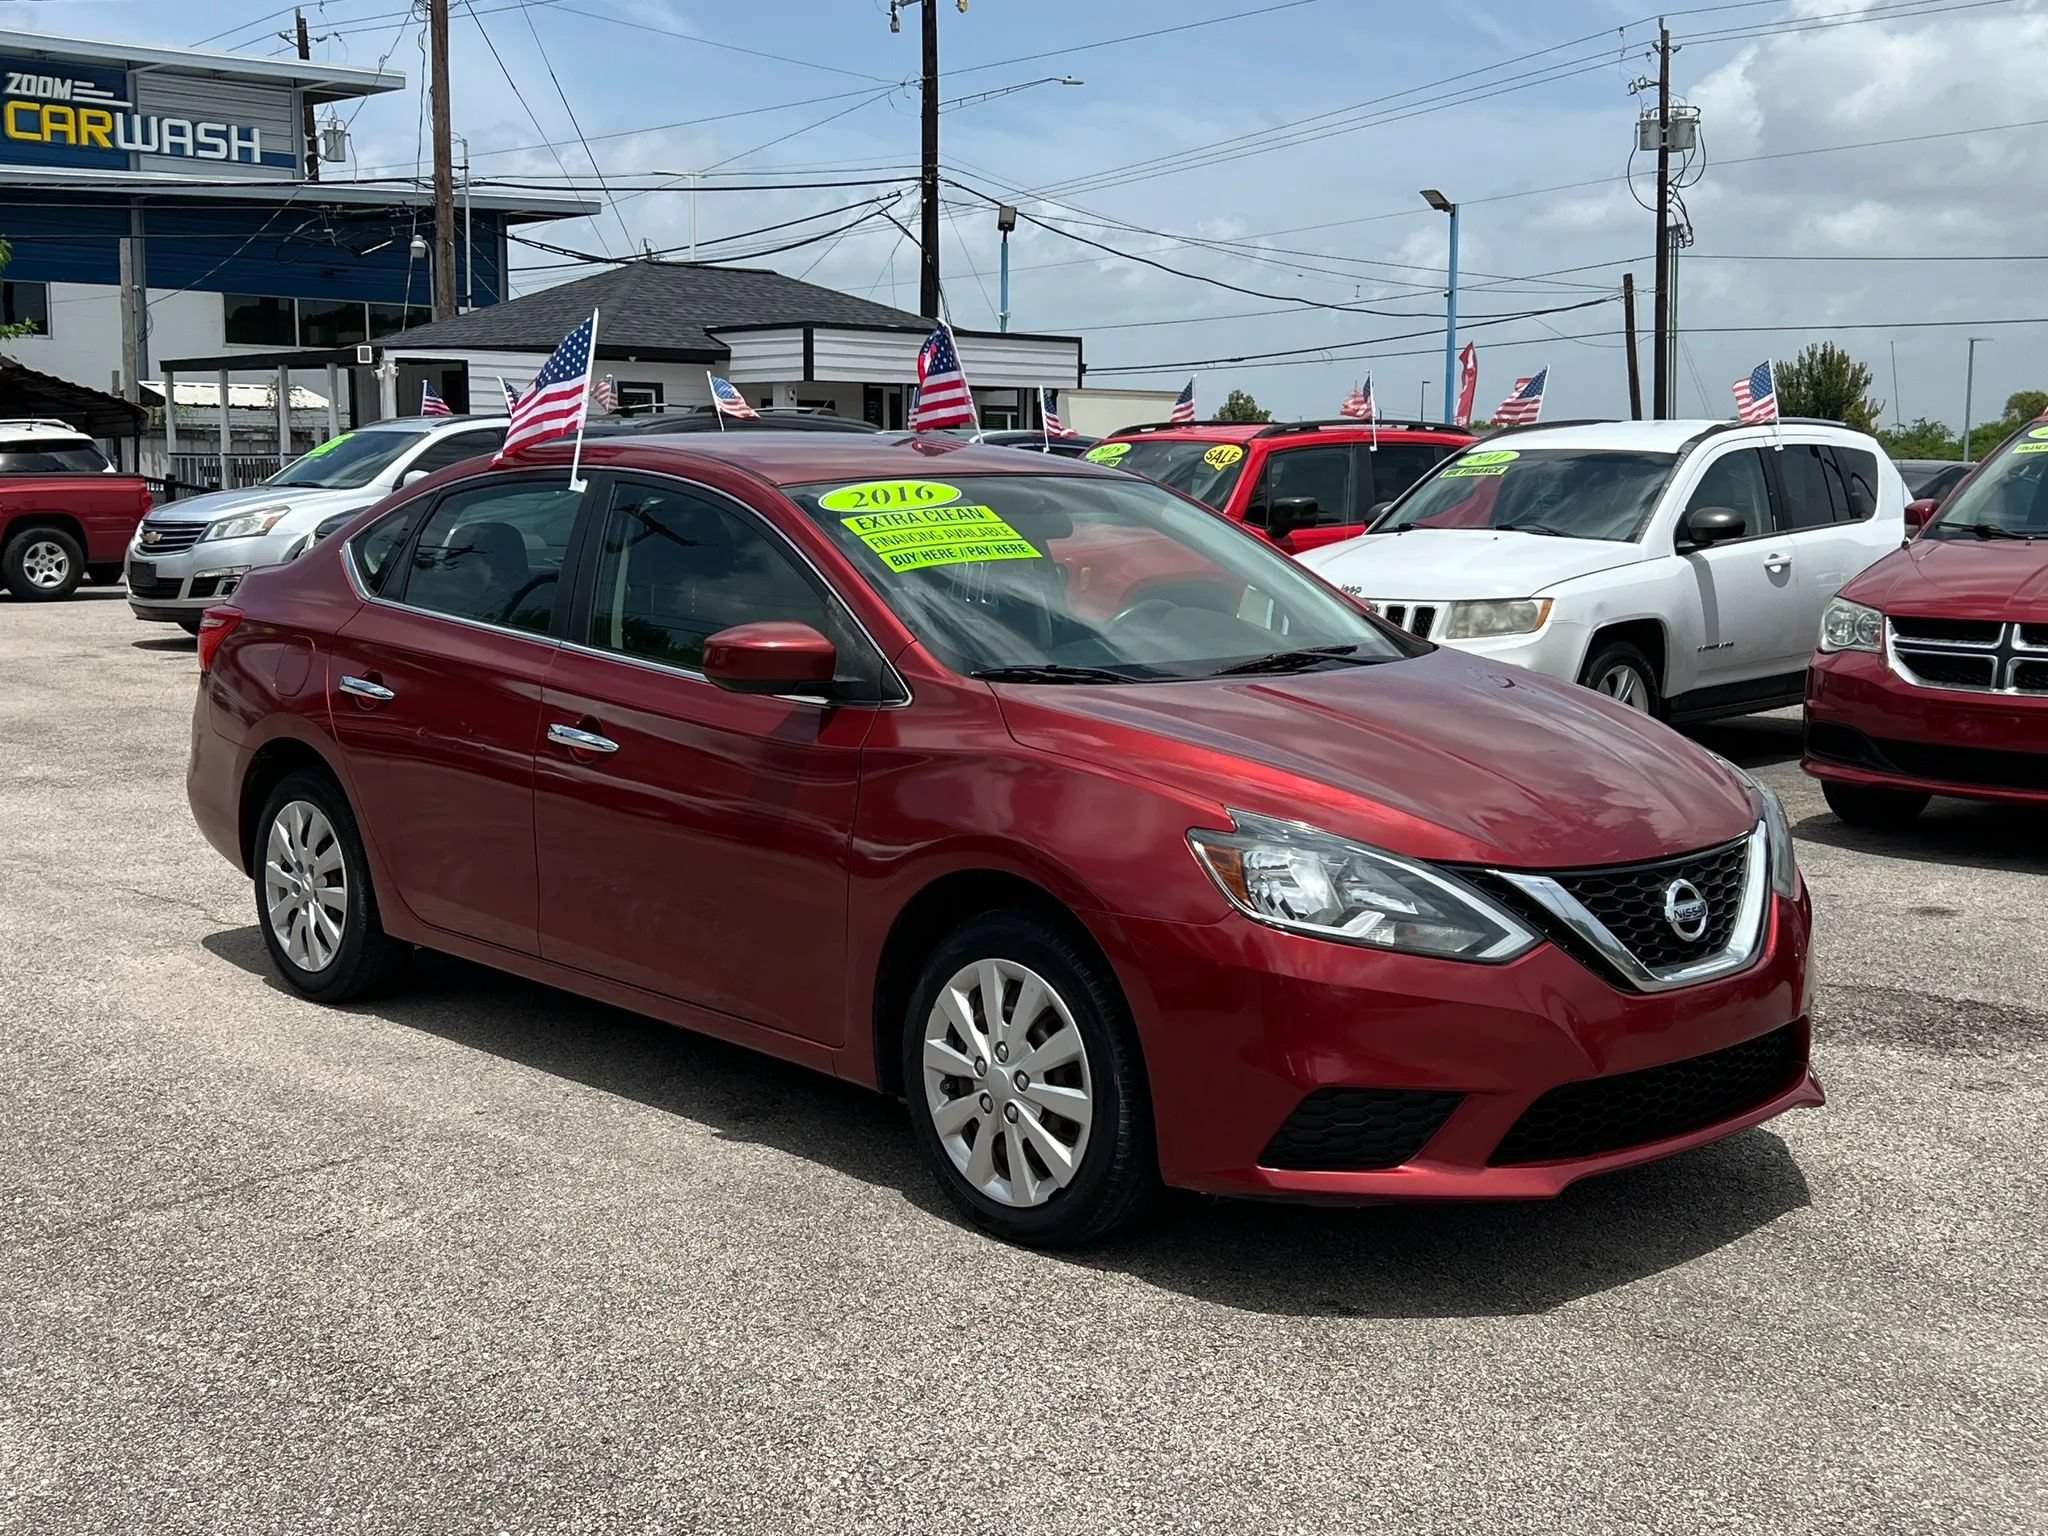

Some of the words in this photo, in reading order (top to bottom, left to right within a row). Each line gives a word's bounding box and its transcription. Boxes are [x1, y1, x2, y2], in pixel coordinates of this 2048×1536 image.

[5, 72, 72, 100] ZOOM
[1206, 448, 1240, 463] SALE
[1461, 466, 1505, 475] FINANCE
[848, 485, 934, 508] 2016
[855, 512, 923, 530] EXTRA
[924, 507, 985, 523] CLEAN
[870, 530, 943, 549] FINANCING
[944, 526, 1013, 543] AVAILABLE
[890, 551, 919, 567] BUY
[920, 547, 958, 561] HERE
[967, 545, 992, 557] PAY
[994, 543, 1029, 554] HERE
[1673, 901, 1706, 919] NISSA
